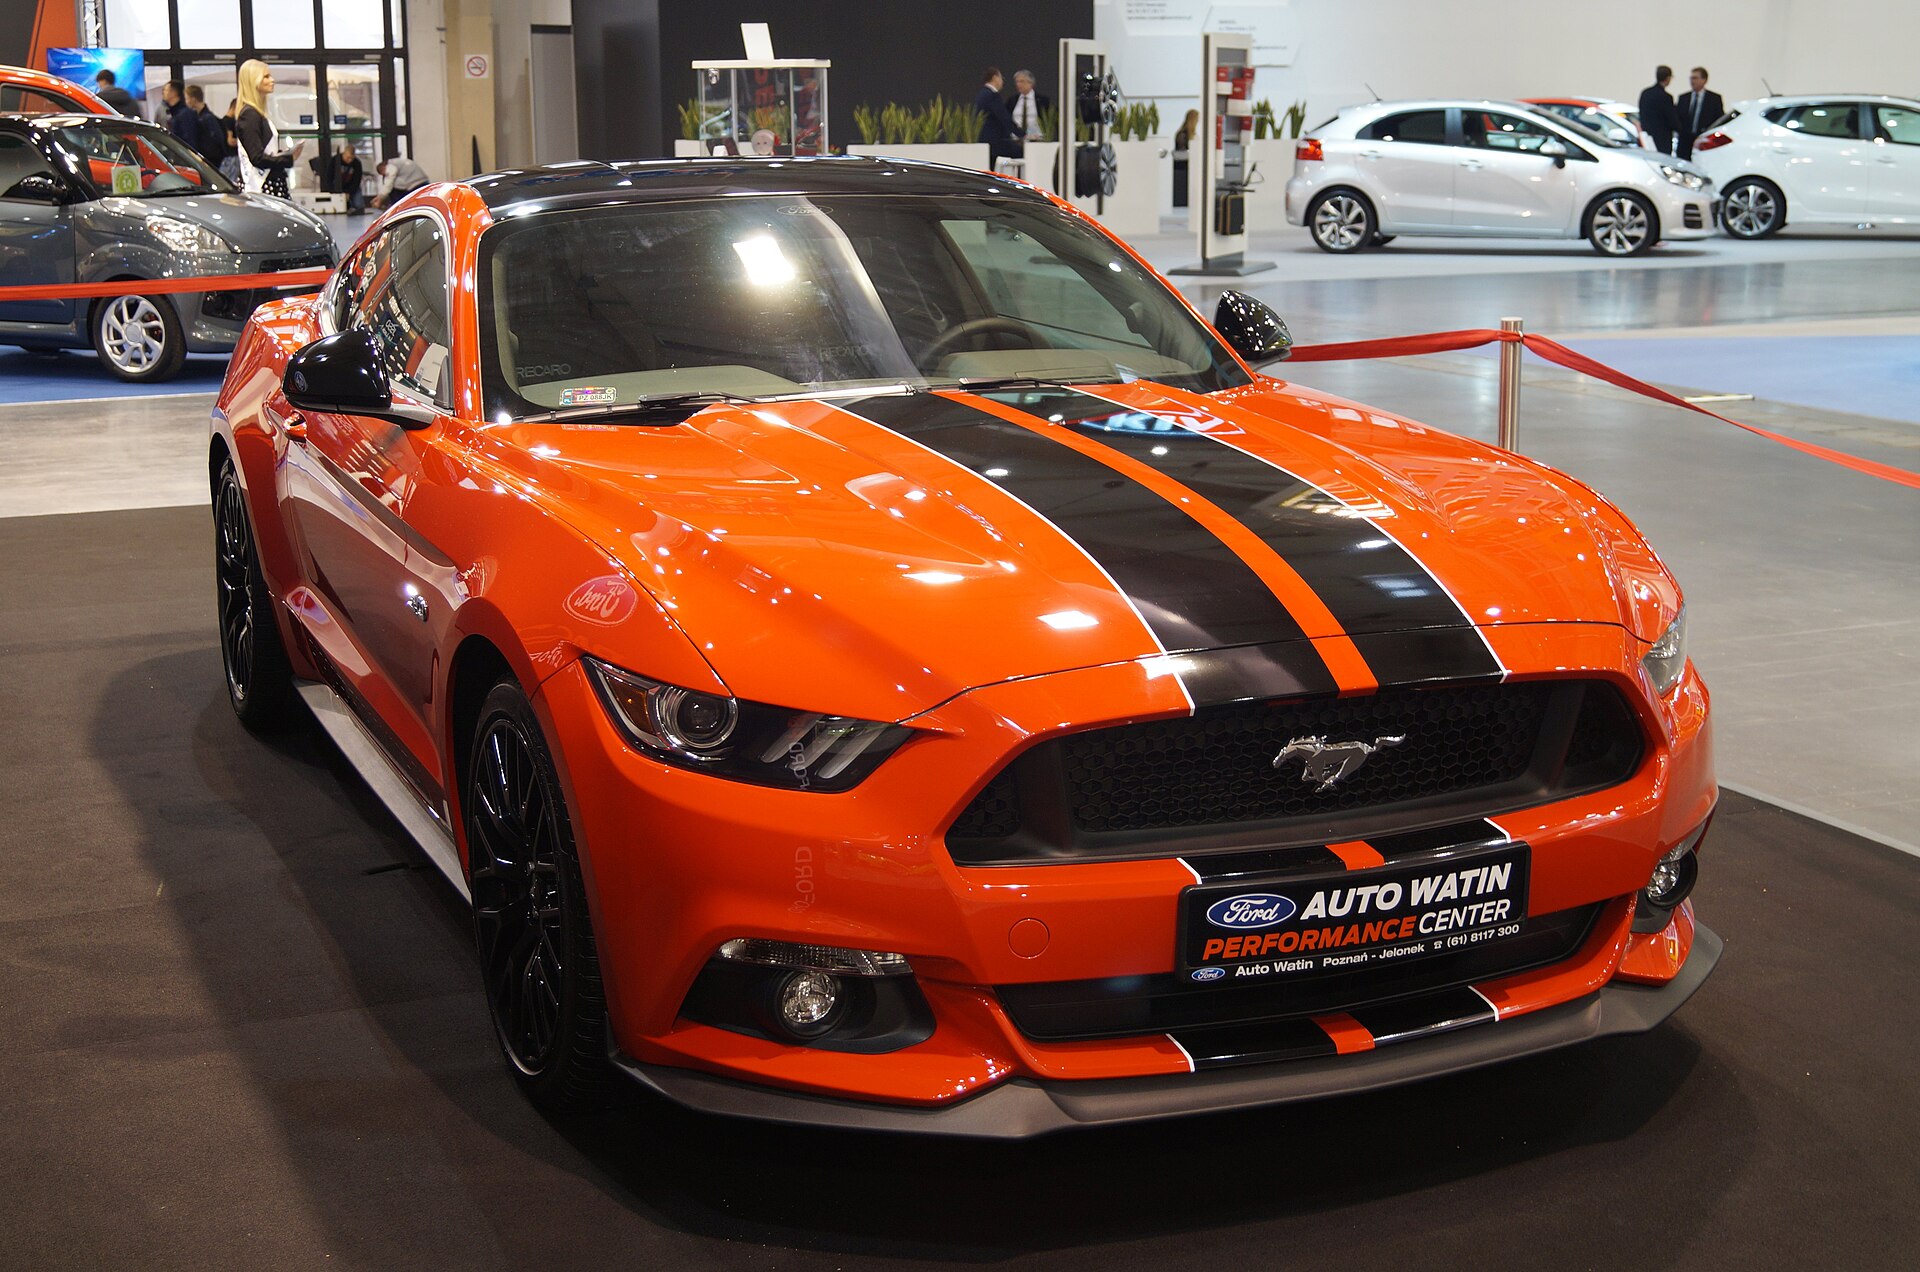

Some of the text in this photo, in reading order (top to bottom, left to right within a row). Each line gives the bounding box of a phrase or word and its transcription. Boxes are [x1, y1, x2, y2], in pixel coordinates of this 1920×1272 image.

[515, 363, 572, 378] RECARO
[1223, 898, 1280, 923] Ford
[1300, 862, 1512, 920] AUTO WATIN
[1202, 898, 1511, 961] PERFORMANCE CENTER
[1234, 963, 1270, 977] Auto
[1273, 958, 1314, 973] Watin
[1322, 951, 1368, 967] Poznań
[1378, 943, 1425, 959] Jelonek
[1447, 933, 1468, 949] (61)
[1470, 928, 1496, 943] 8117
[1497, 924, 1520, 938] 300
[1196, 969, 1220, 980] Ford
